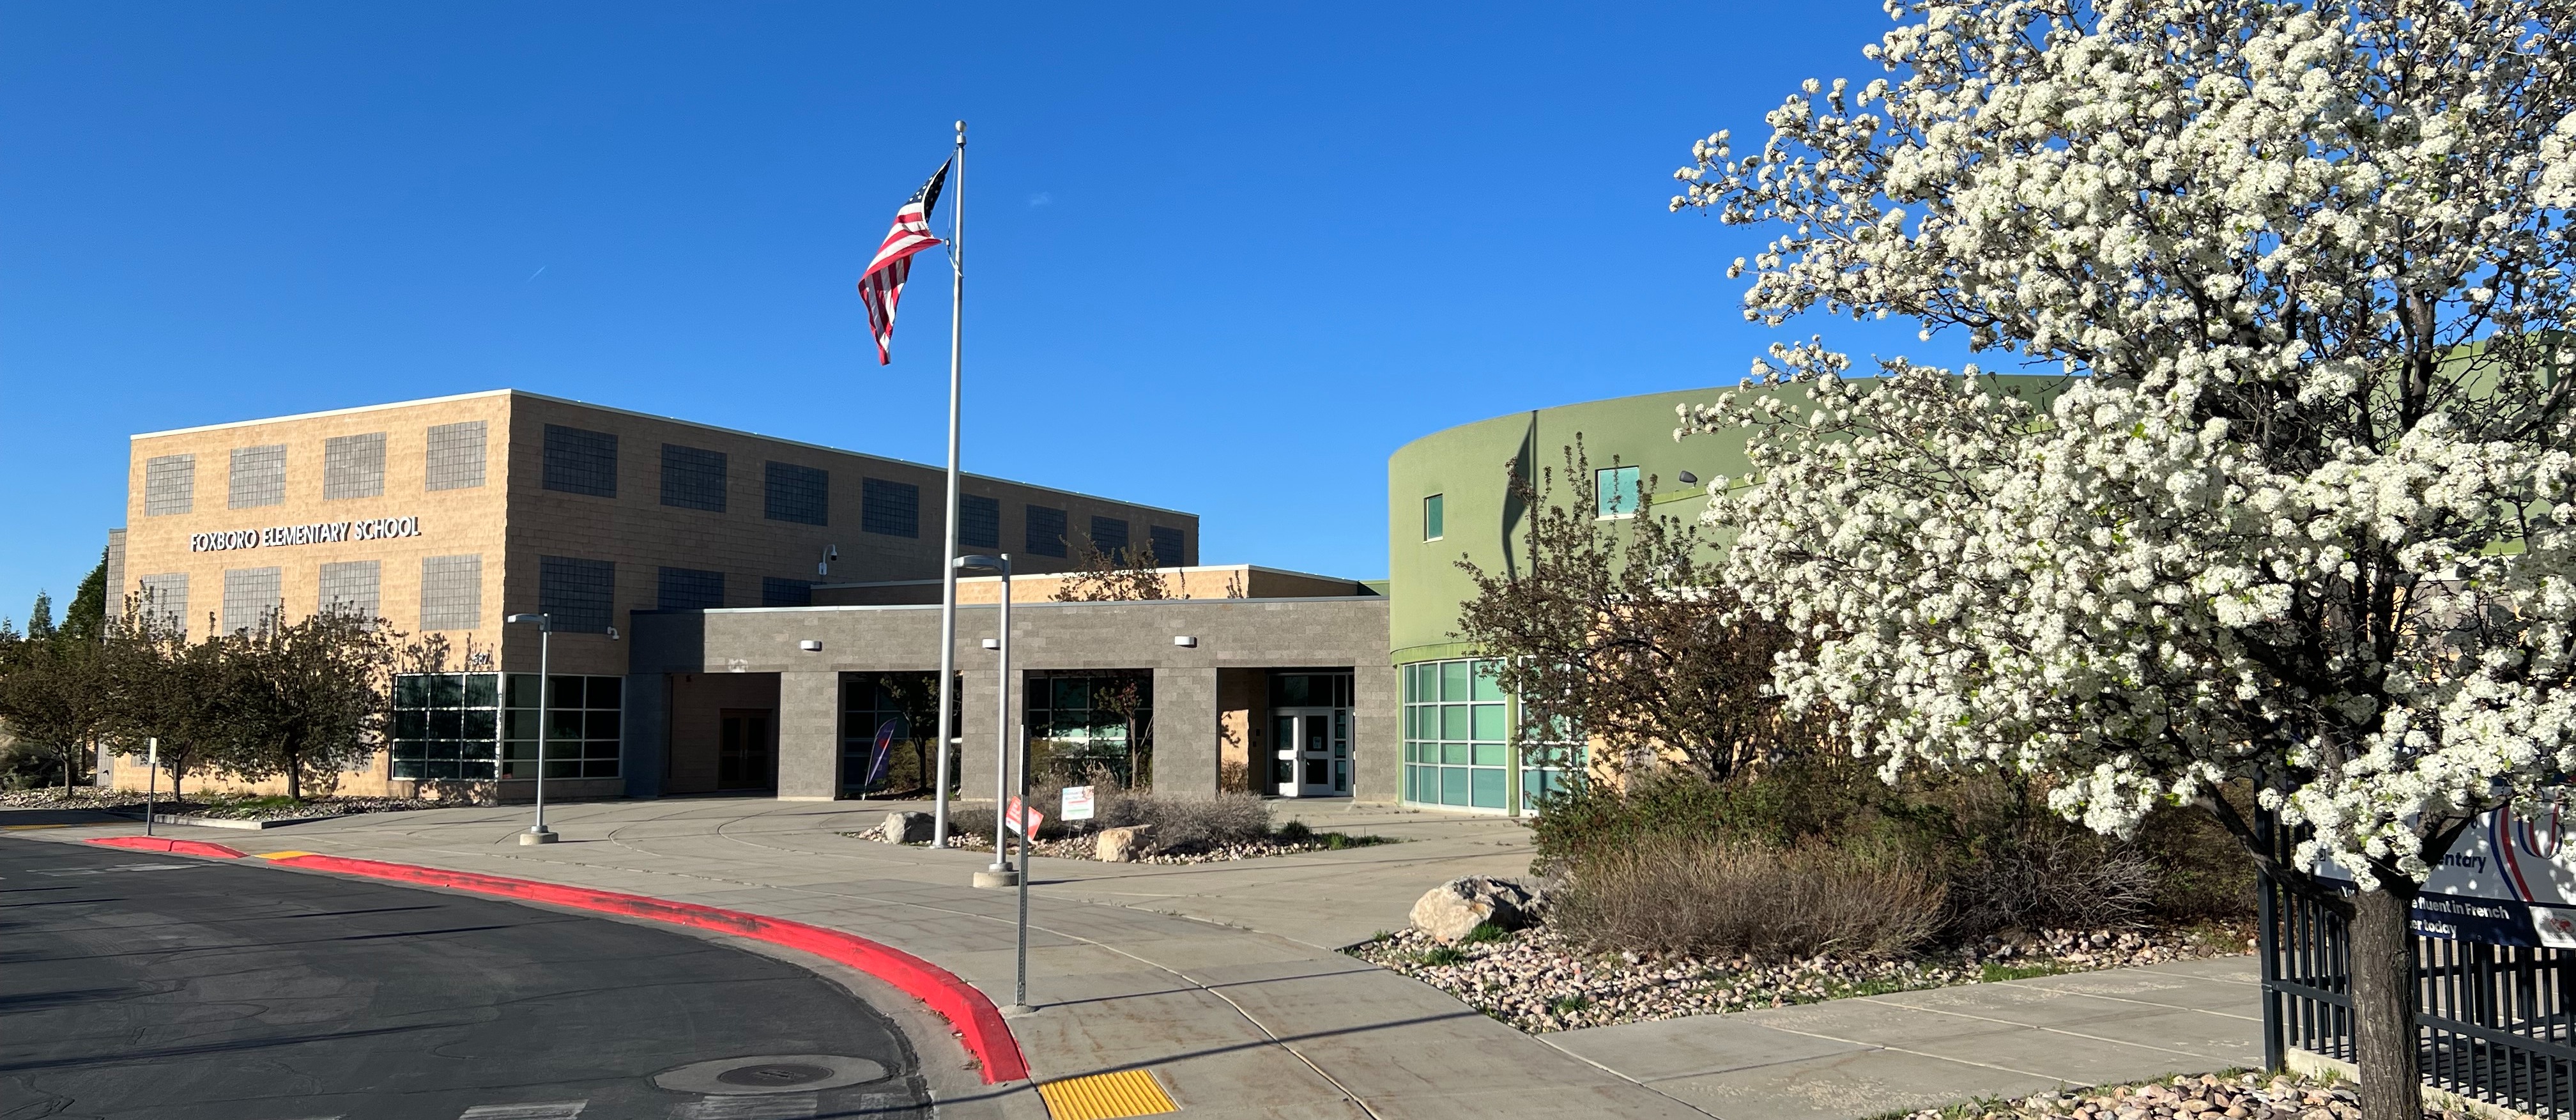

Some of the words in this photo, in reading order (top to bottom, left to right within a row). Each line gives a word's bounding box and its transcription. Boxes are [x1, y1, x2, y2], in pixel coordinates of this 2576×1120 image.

[191, 529, 259, 552] FOXBORO
[263, 521, 351, 547] ELEMENTARY
[354, 516, 422, 541] SCHOOL
[2418, 896, 2451, 913] fluent
[2451, 900, 2464, 915] in
[2465, 903, 2510, 919] French
[2423, 919, 2457, 939] today
